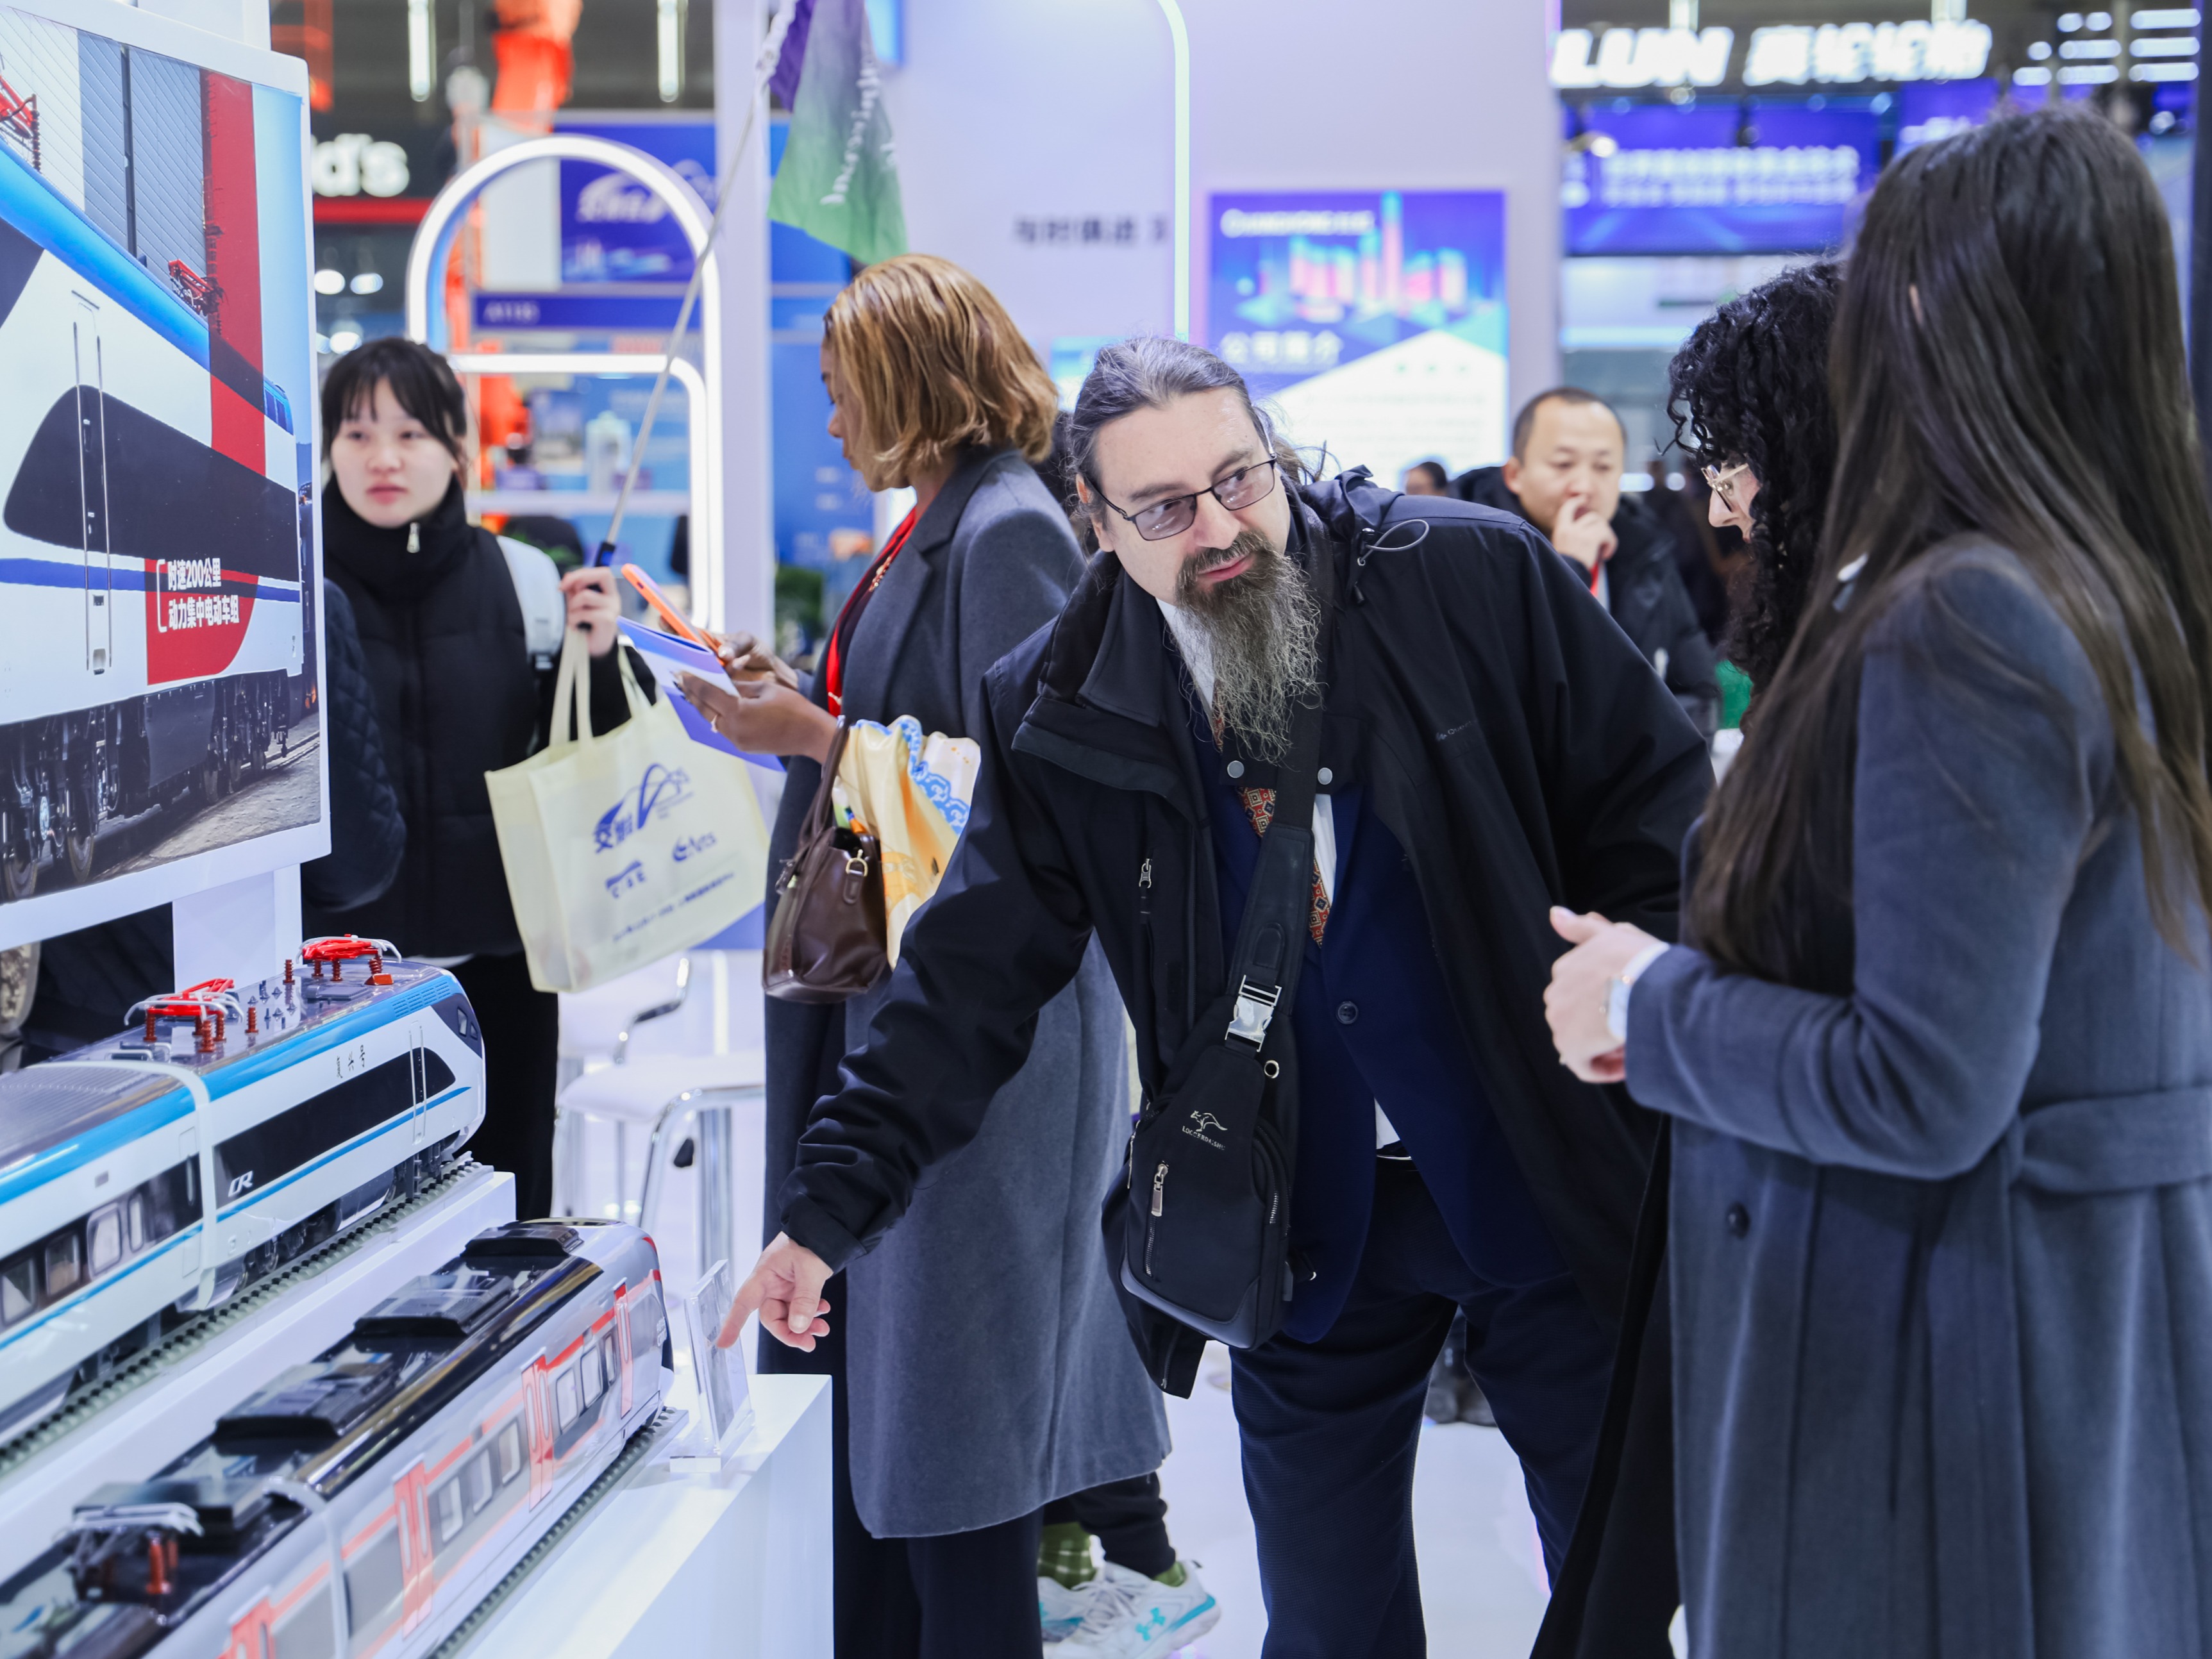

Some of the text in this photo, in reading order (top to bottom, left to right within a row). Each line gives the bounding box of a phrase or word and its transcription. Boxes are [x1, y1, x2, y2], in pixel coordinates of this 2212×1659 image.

[167, 557, 222, 591] 时速200公里
[169, 595, 240, 630] 动力集中电动车组
[228, 1170, 253, 1197] CR
